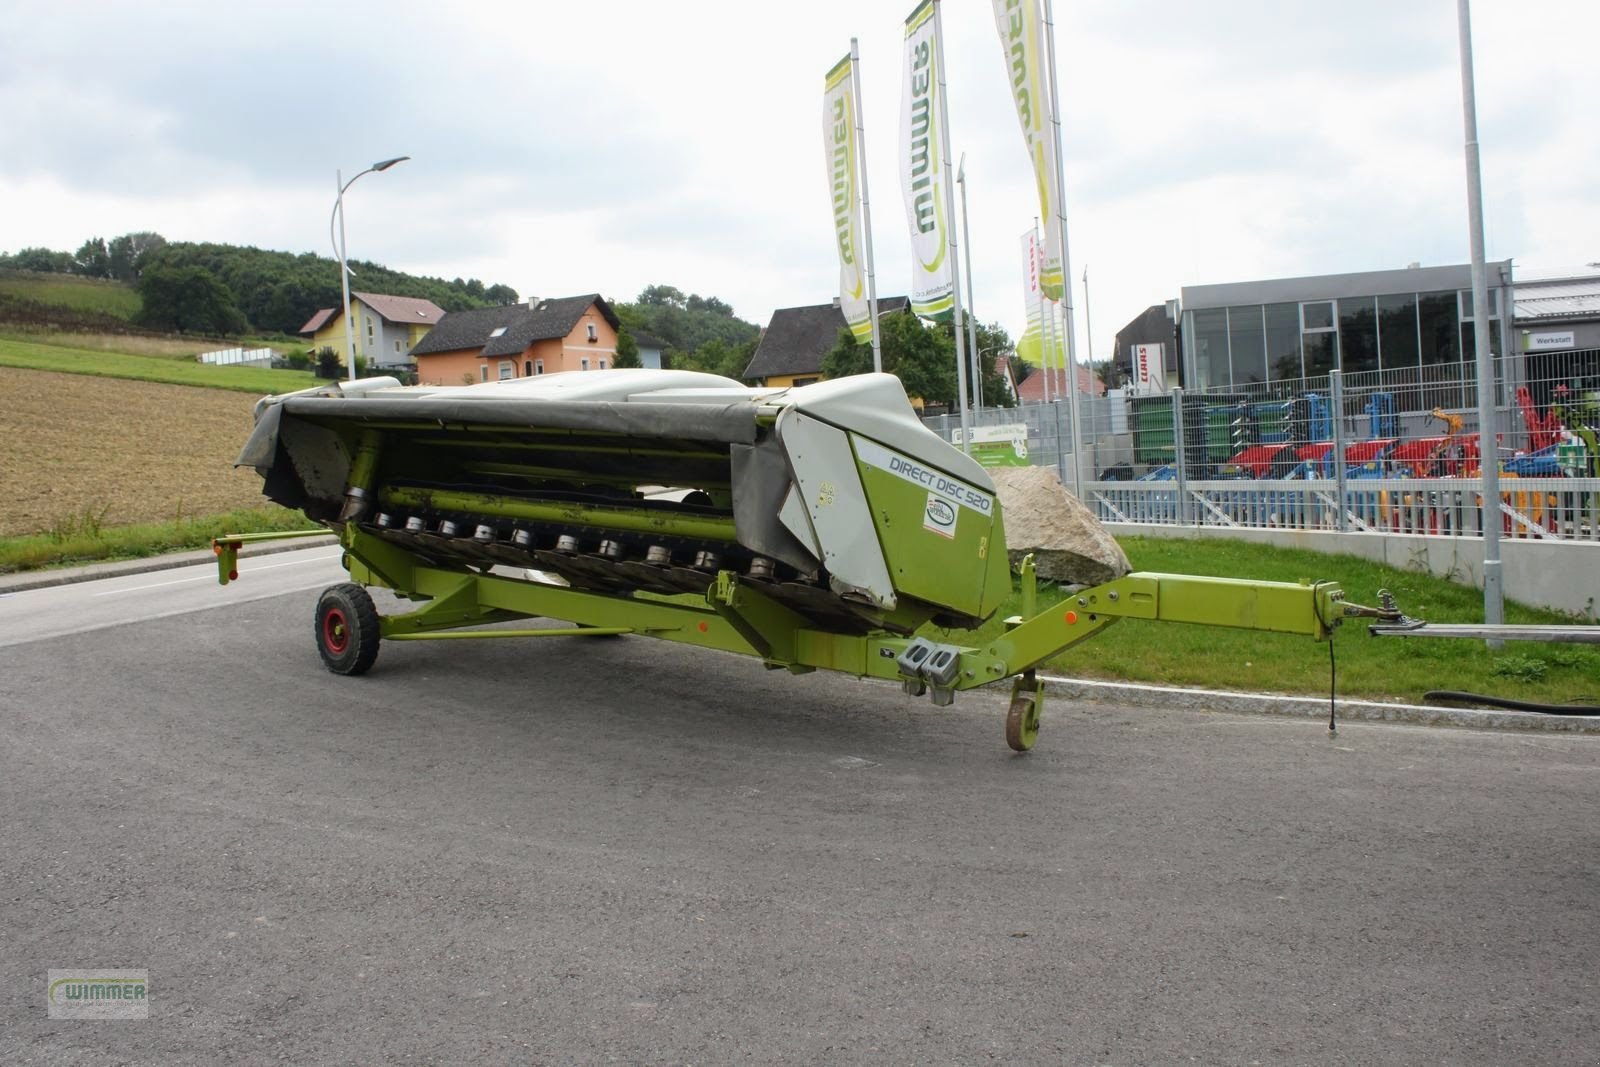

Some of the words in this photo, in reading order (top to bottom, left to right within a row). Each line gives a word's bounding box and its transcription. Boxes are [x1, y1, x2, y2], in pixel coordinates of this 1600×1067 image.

[1536, 333, 1571, 346] Werkstatt
[1139, 347, 1148, 383] CLAAS
[889, 457, 936, 486] DIRECT
[936, 479, 966, 500] DISC
[965, 492, 990, 511] 520
